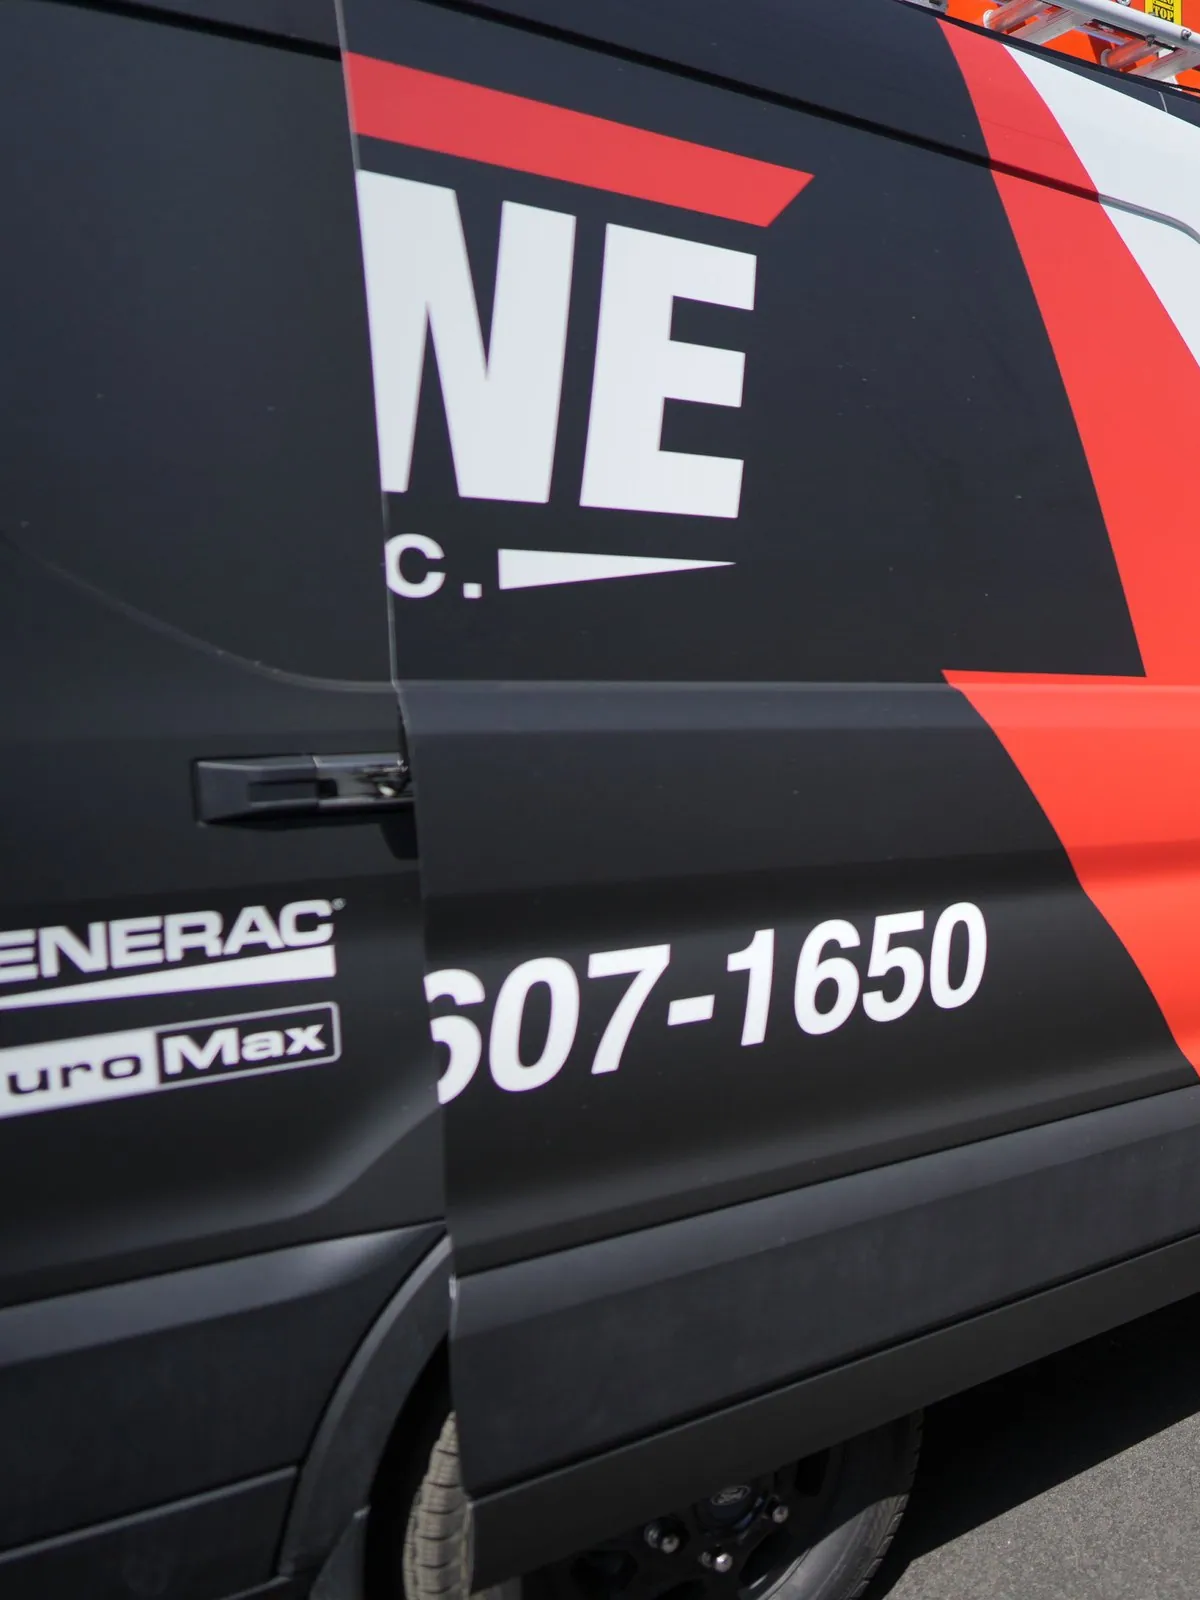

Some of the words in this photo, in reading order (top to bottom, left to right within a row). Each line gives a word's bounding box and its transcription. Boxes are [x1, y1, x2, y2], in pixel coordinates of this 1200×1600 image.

[355, 168, 757, 519] NE
[0, 899, 334, 984] ENERAC
[423, 901, 987, 1105] 607-1650
